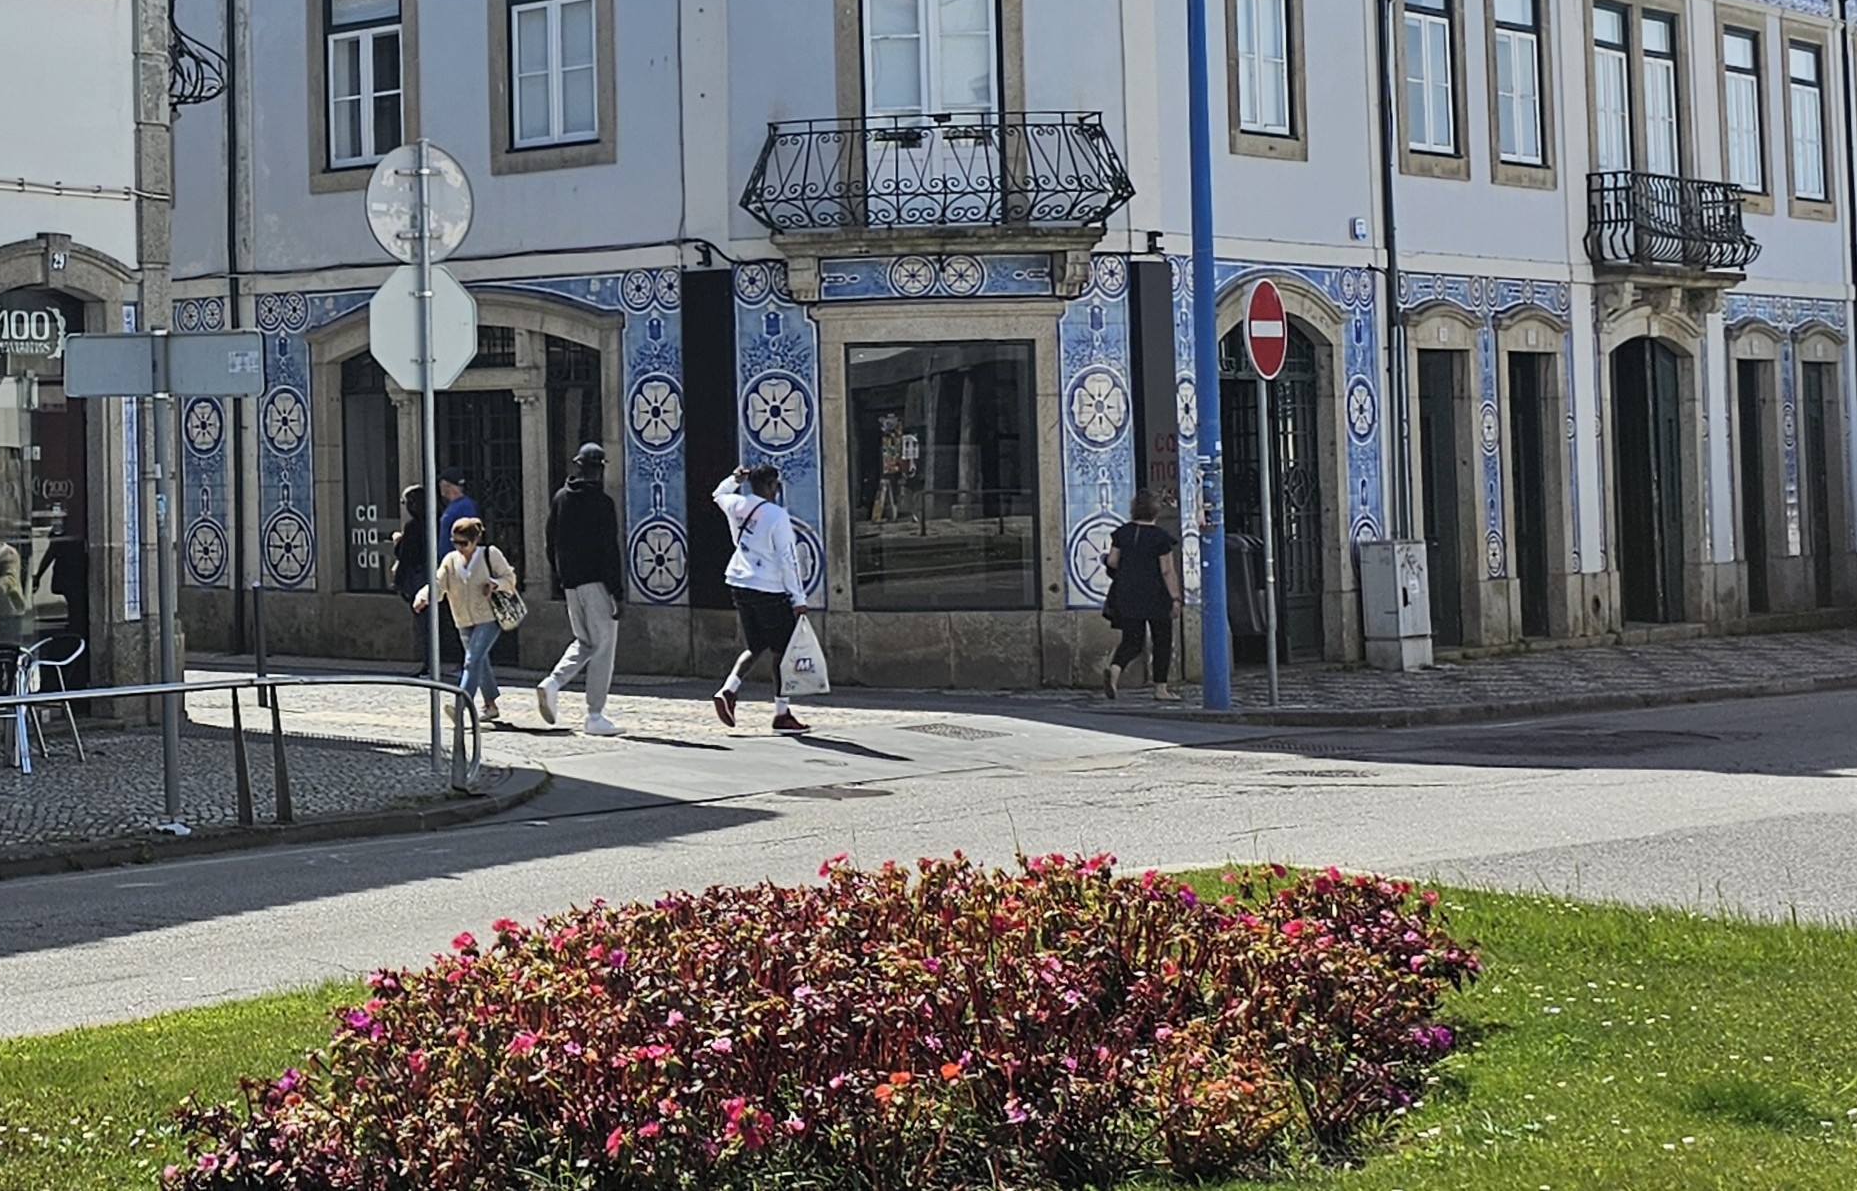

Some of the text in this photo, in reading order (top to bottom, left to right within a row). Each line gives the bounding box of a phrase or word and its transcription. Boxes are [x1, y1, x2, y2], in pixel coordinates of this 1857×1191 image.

[355, 504, 378, 522] ca
[351, 527, 379, 545] ma
[357, 547, 380, 568] da
